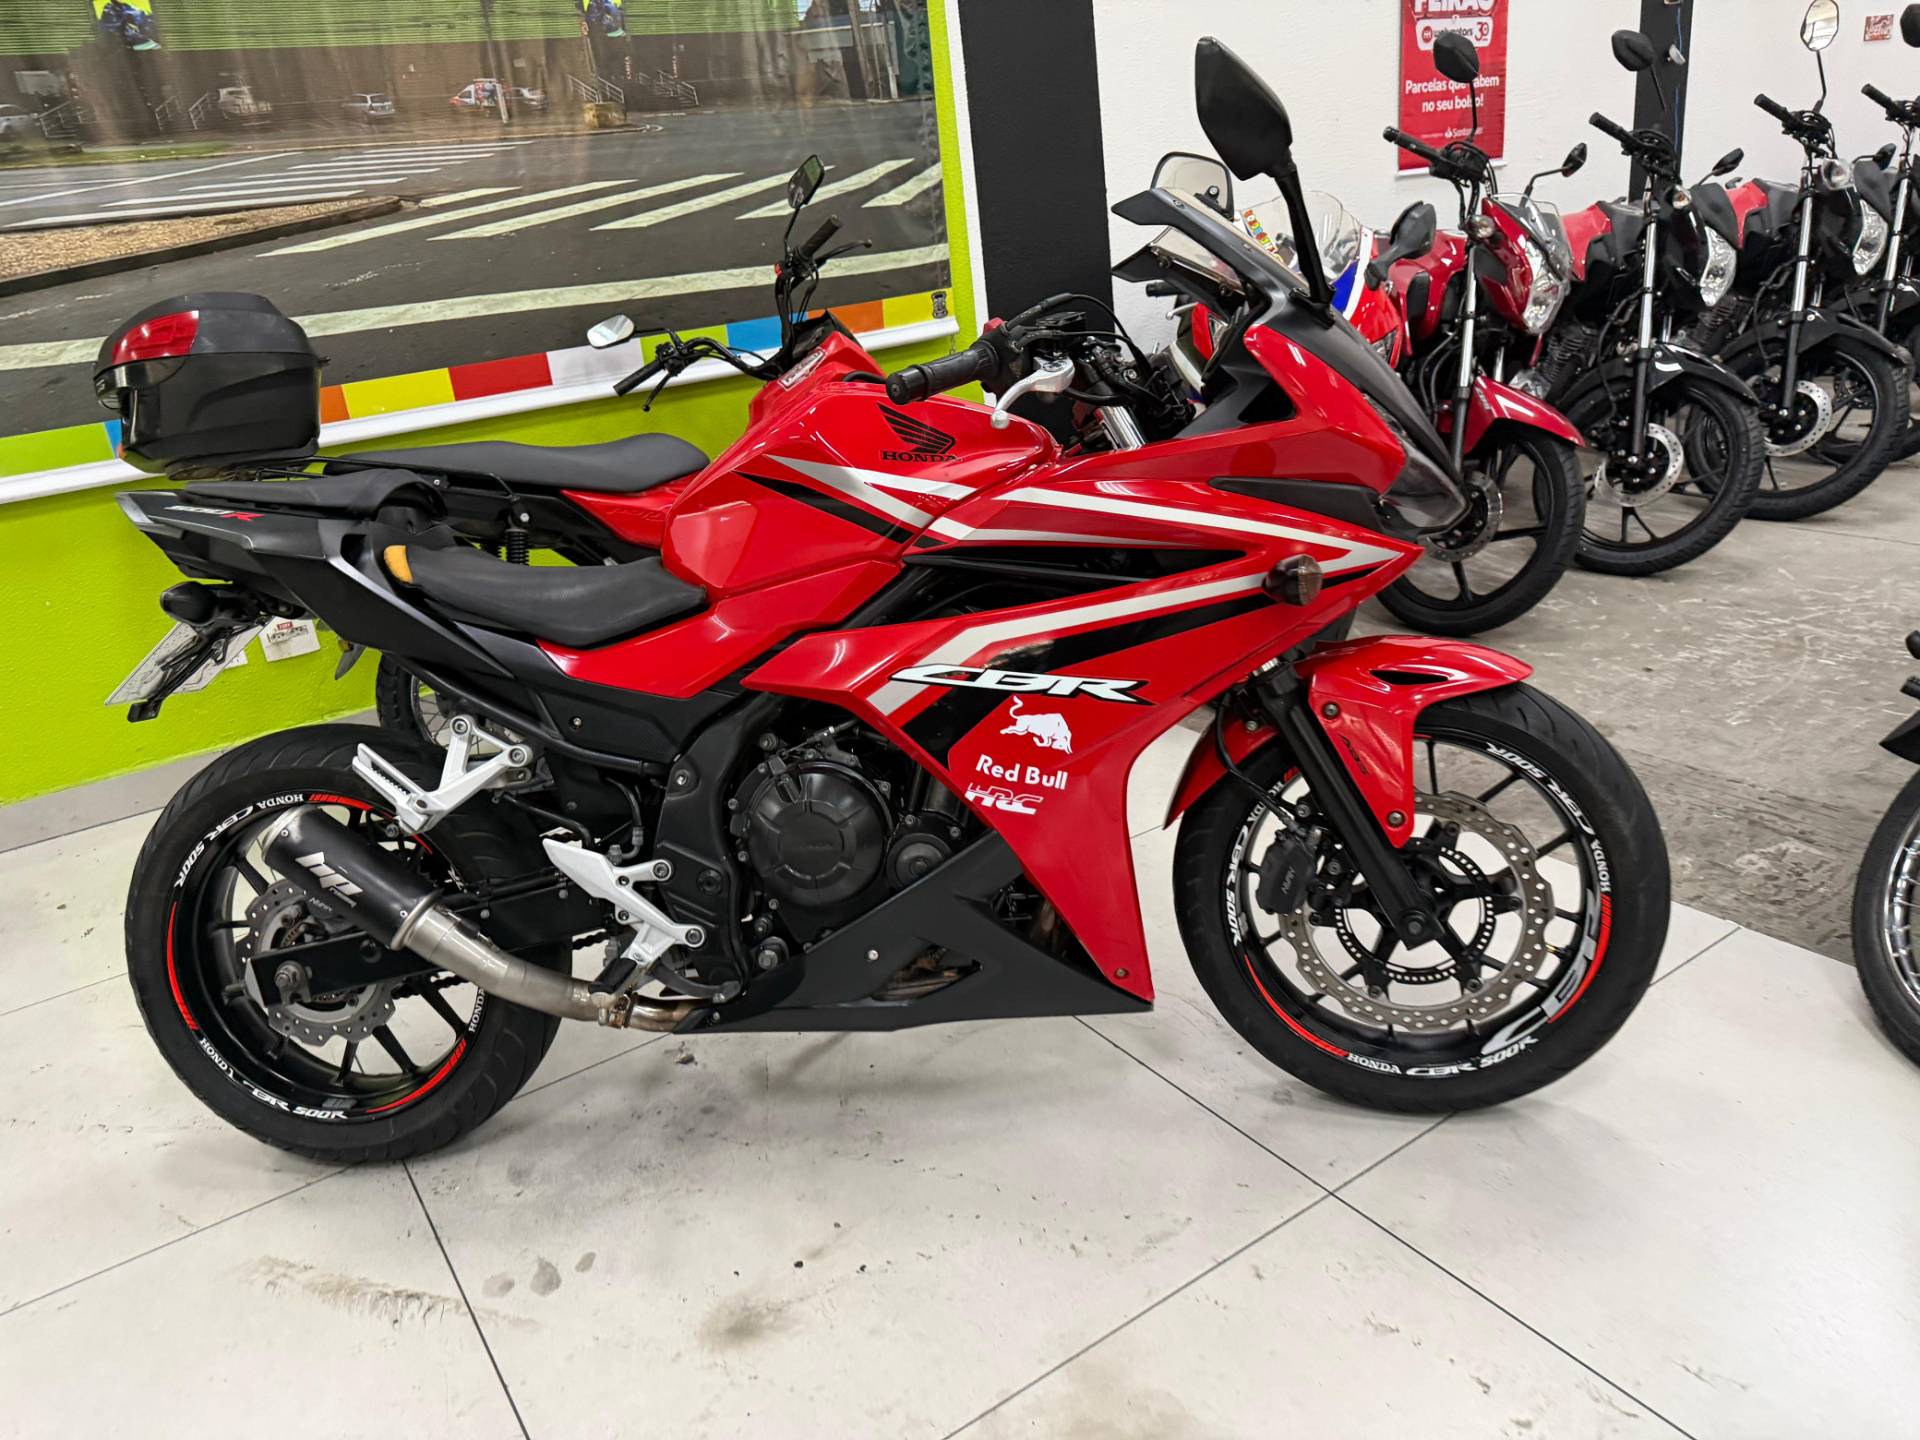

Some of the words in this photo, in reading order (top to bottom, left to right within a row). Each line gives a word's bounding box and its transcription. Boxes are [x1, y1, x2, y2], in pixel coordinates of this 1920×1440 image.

[1405, 78, 1447, 94] Parcelas
[1467, 75, 1500, 88] abem
[1422, 100, 1435, 112] no
[1437, 98, 1453, 111] seu
[882, 451, 961, 462] HONDA
[889, 664, 1153, 704] CBR
[975, 754, 1021, 783] Red
[1025, 766, 1068, 790] Bull
[1486, 741, 1547, 779] 500R
[256, 793, 304, 809] HONDA
[964, 783, 1044, 815] HRC
[1247, 781, 1284, 822] HODA
[1547, 778, 1596, 835] CBR
[203, 805, 254, 841] CBR
[174, 841, 205, 888] 500R
[1226, 825, 1249, 886] CBR
[1591, 839, 1611, 892] HONDA
[1226, 888, 1242, 947] 500R
[1347, 1053, 1402, 1075] HONDA
[1405, 1062, 1478, 1076] CBR
[1479, 1036, 1539, 1068] 500R
[292, 1106, 348, 1120] 500R
